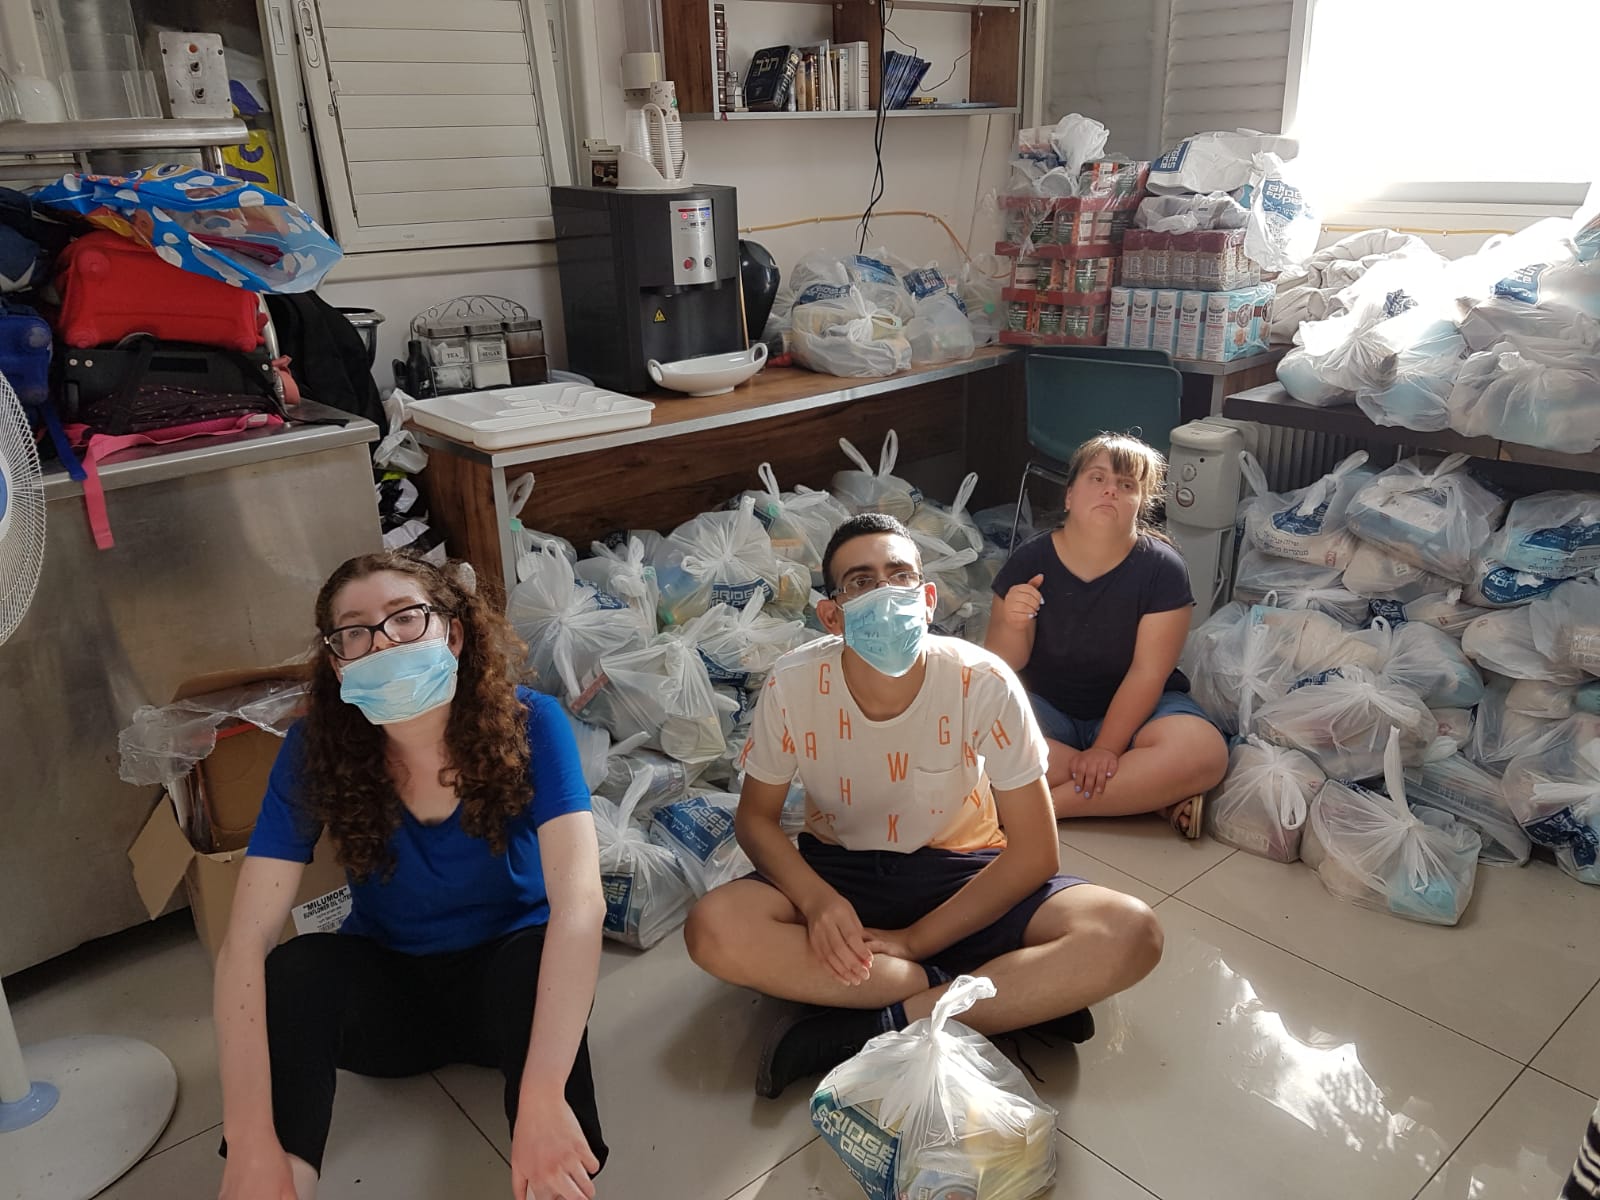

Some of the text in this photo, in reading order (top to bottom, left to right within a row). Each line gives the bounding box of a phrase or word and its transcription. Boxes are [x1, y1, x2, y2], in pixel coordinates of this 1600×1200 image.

[447, 351, 460, 359] TEA
[482, 350, 501, 358] SUGAR
[819, 663, 831, 695] G
[839, 708, 852, 740] H
[938, 715, 951, 745] G
[991, 719, 1011, 750] H
[804, 731, 817, 761] A
[887, 751, 909, 783] W
[839, 777, 852, 806] H
[887, 814, 899, 843] K
